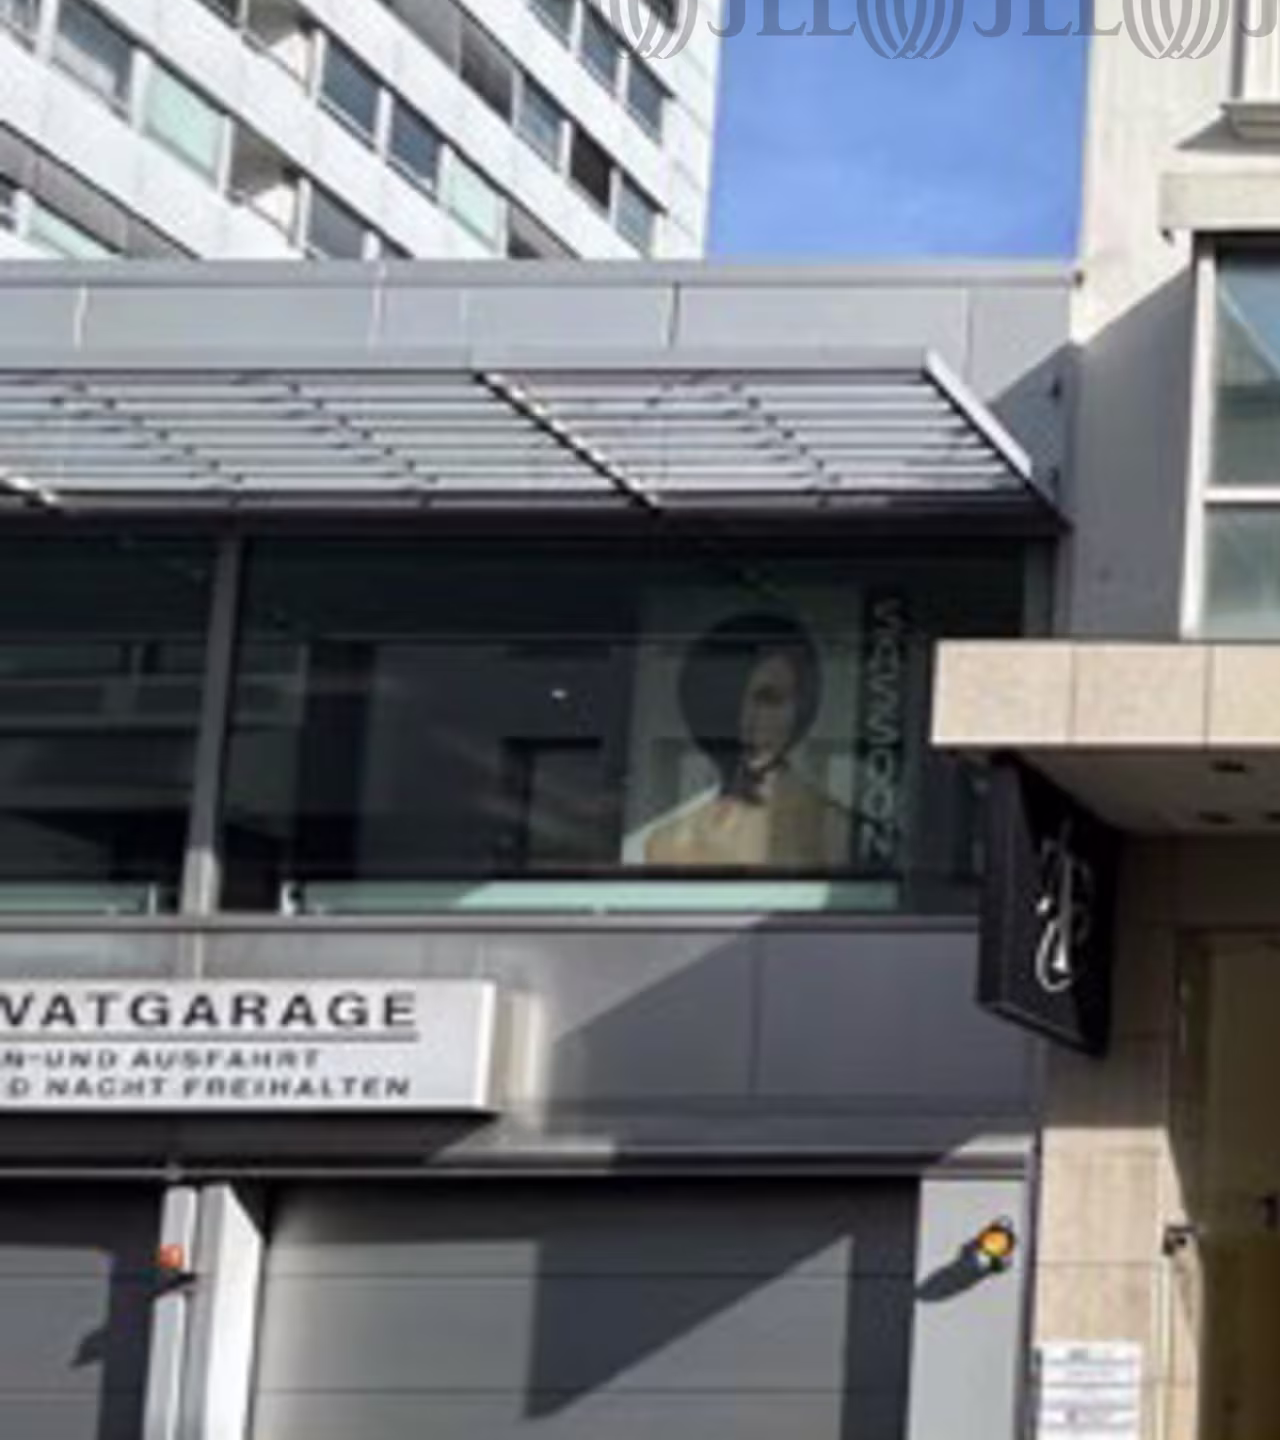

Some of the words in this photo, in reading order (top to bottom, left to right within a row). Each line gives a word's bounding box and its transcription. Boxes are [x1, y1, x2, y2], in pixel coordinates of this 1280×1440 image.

[858, 596, 908, 858] SASSOON
[0, 992, 417, 1028] VATGARAGE
[130, 1048, 321, 1068] AUSFAHRT
[45, 1077, 168, 1098] NACHT
[182, 1077, 412, 1098] FREIHALTEN
